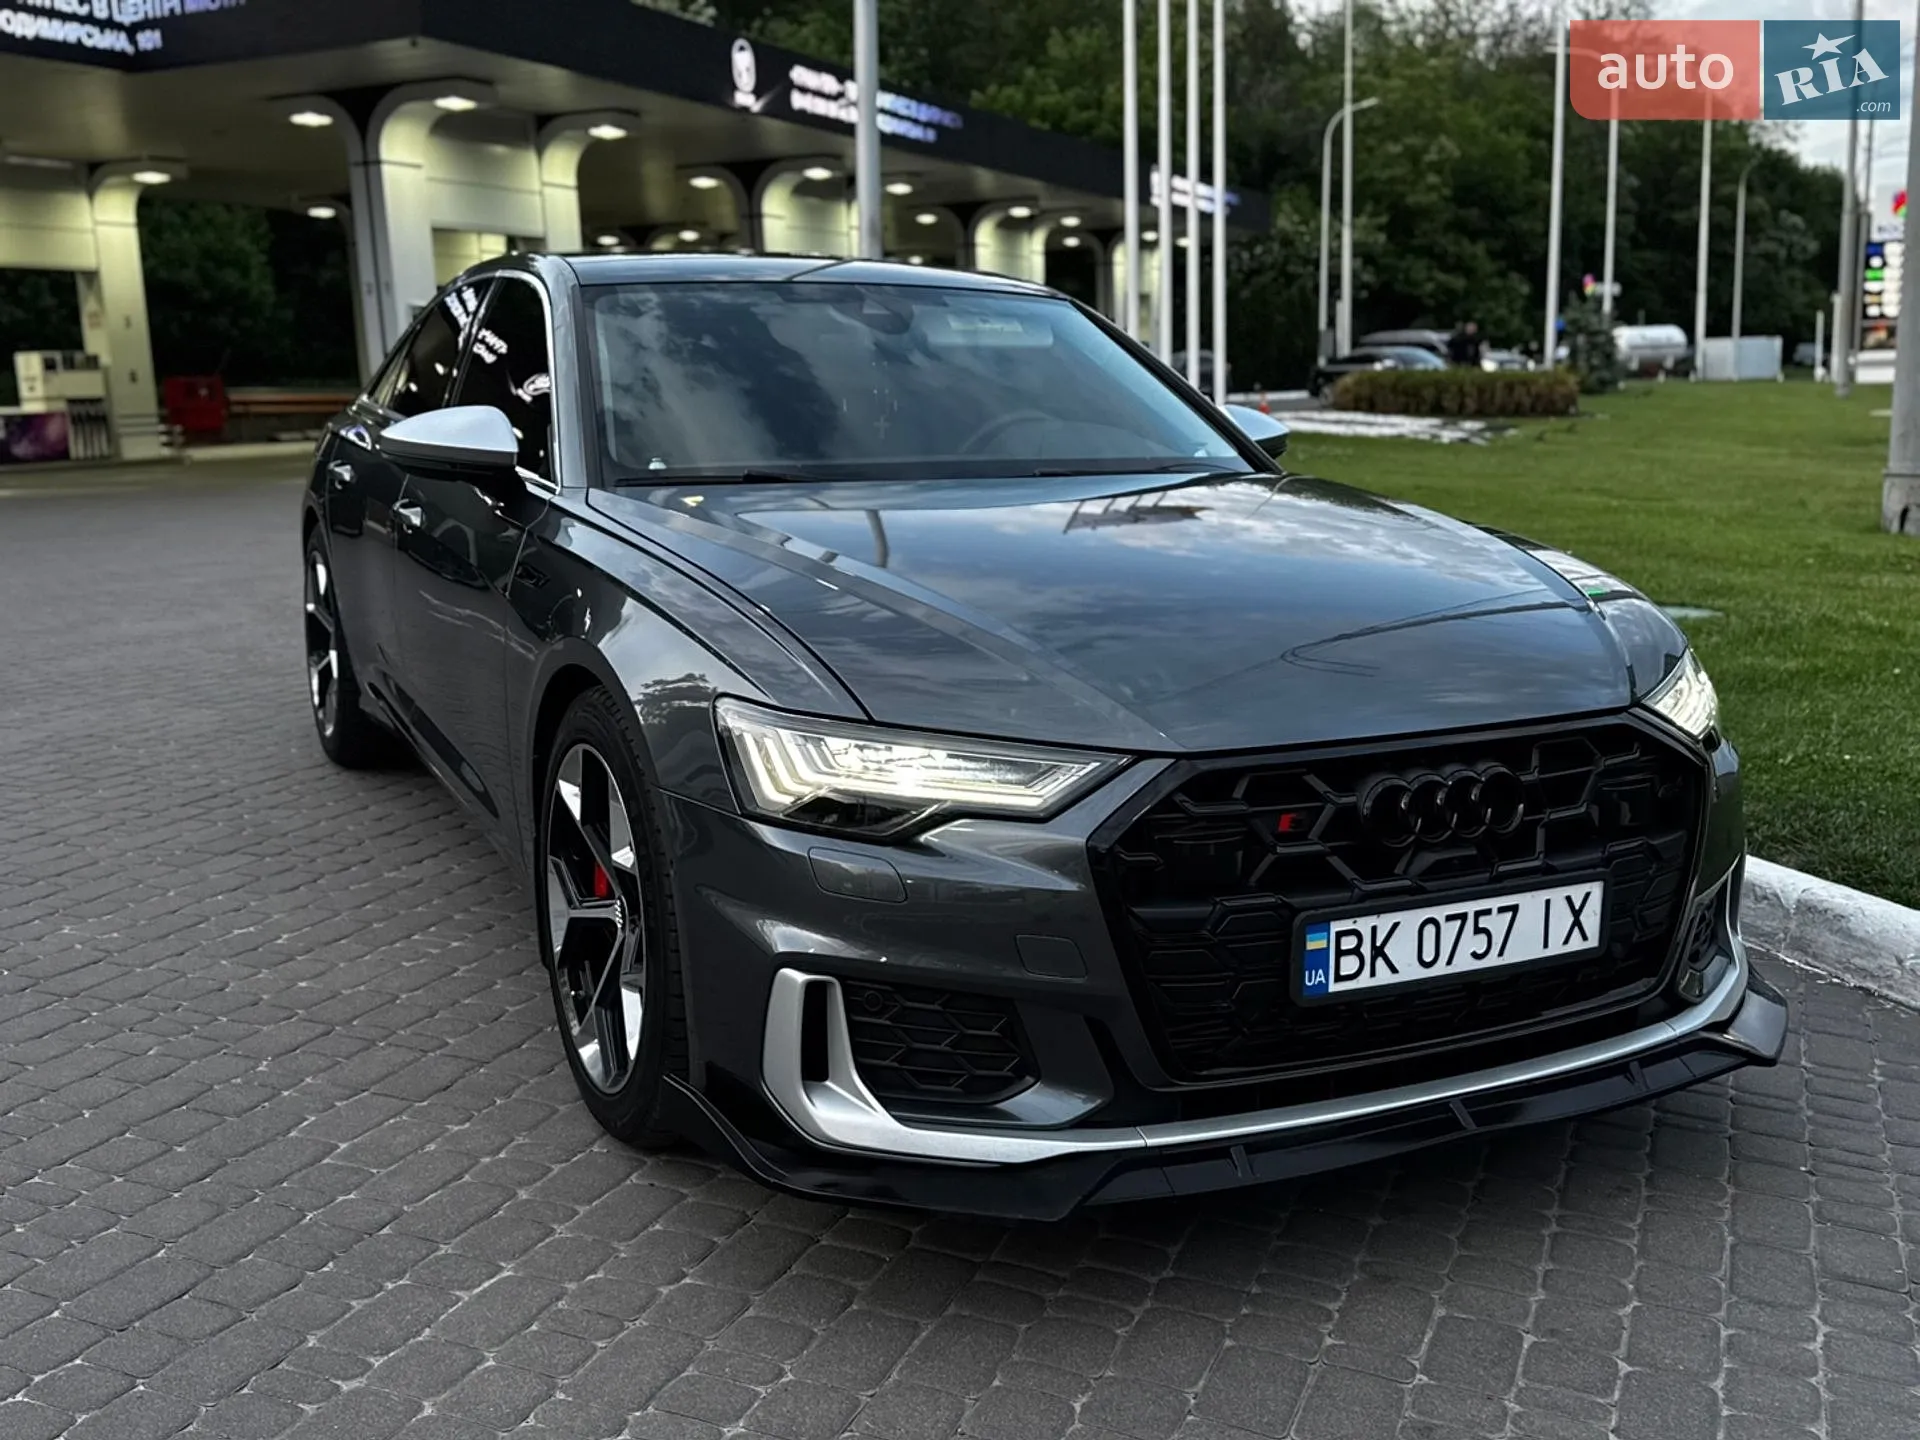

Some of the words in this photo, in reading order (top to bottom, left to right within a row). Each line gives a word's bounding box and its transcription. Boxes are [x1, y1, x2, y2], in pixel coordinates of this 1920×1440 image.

[1333, 921, 1401, 984] BK
[1417, 903, 1520, 969] 0757
[1543, 891, 1592, 949] IX
[1304, 970, 1326, 987] UA
